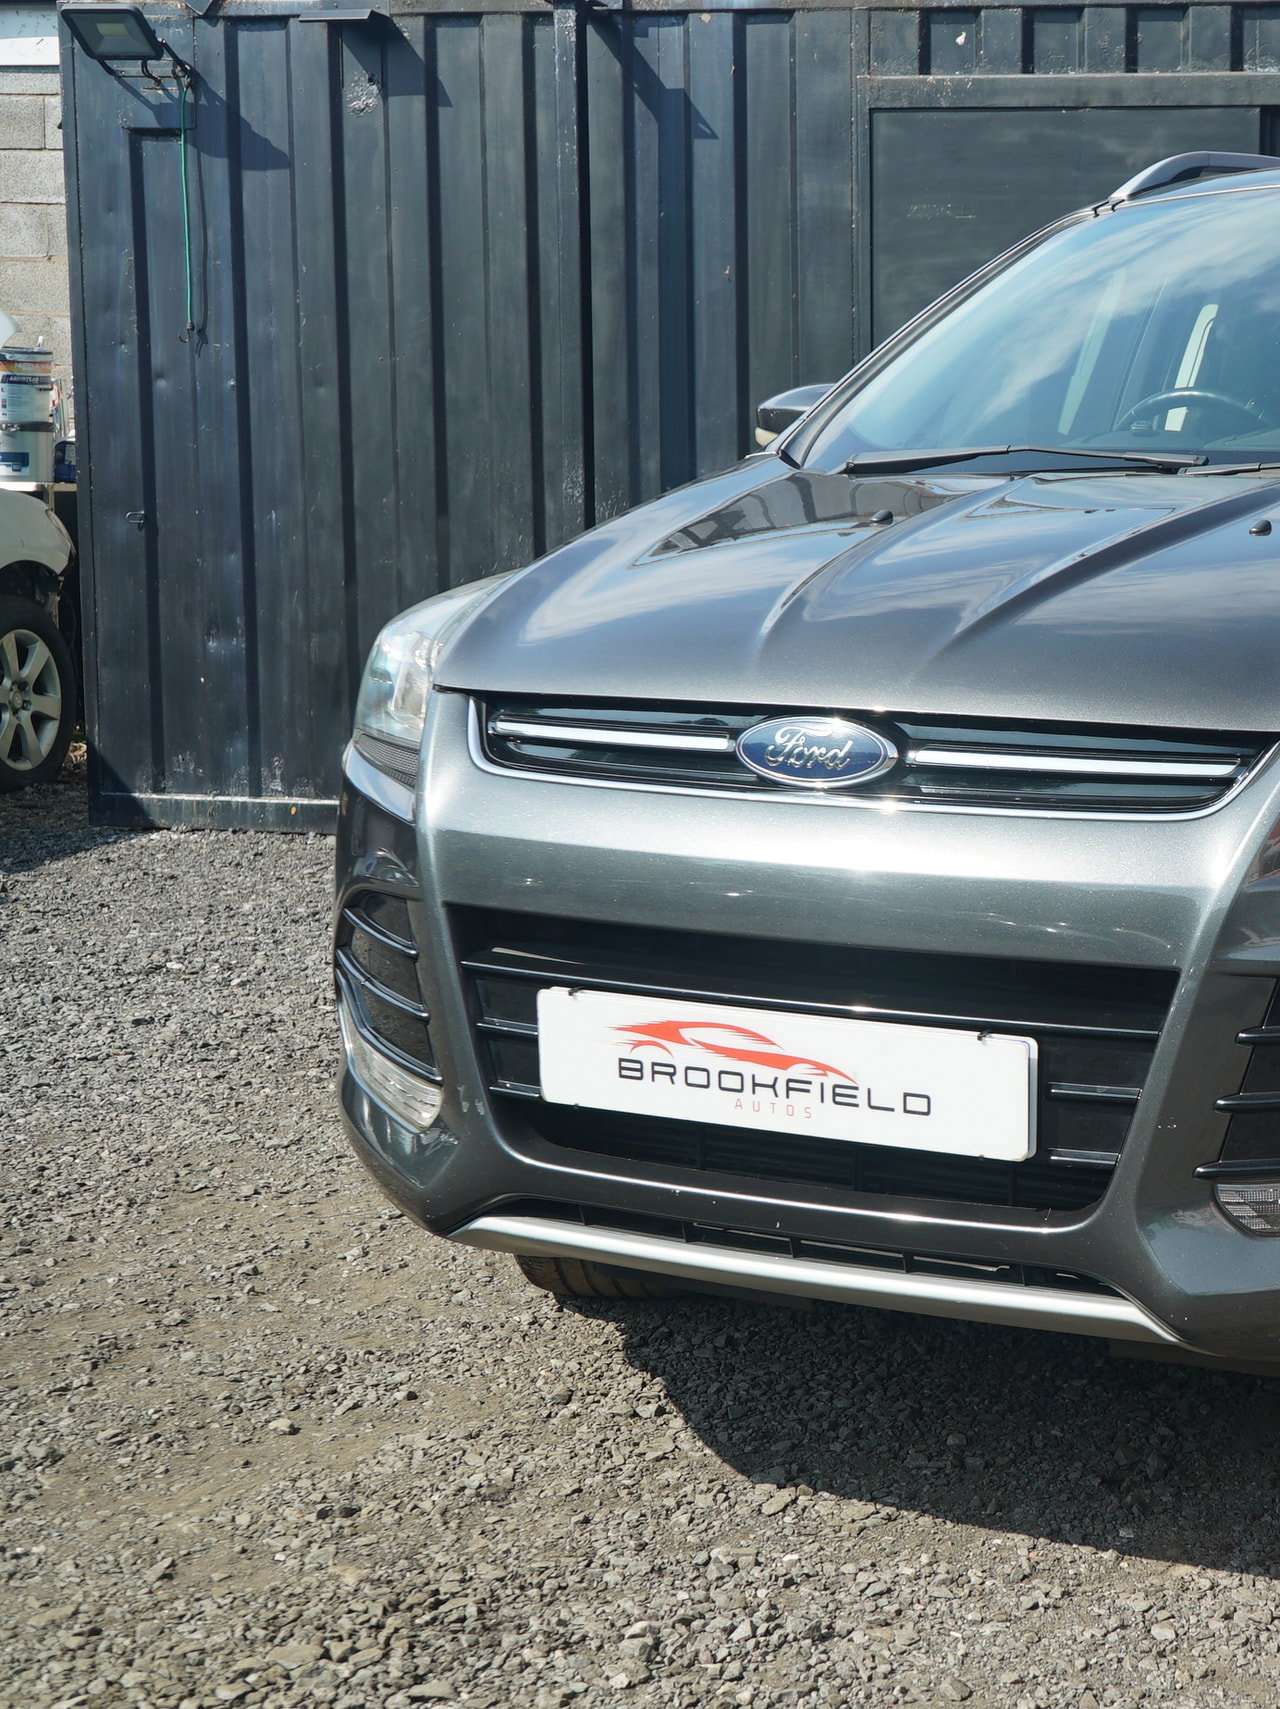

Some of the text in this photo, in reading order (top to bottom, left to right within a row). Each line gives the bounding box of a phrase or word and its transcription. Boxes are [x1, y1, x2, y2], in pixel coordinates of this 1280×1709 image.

[766, 726, 854, 769] Ford
[618, 1057, 931, 1116] BROOKFIELD
[734, 1098, 812, 1119] AUTOS
